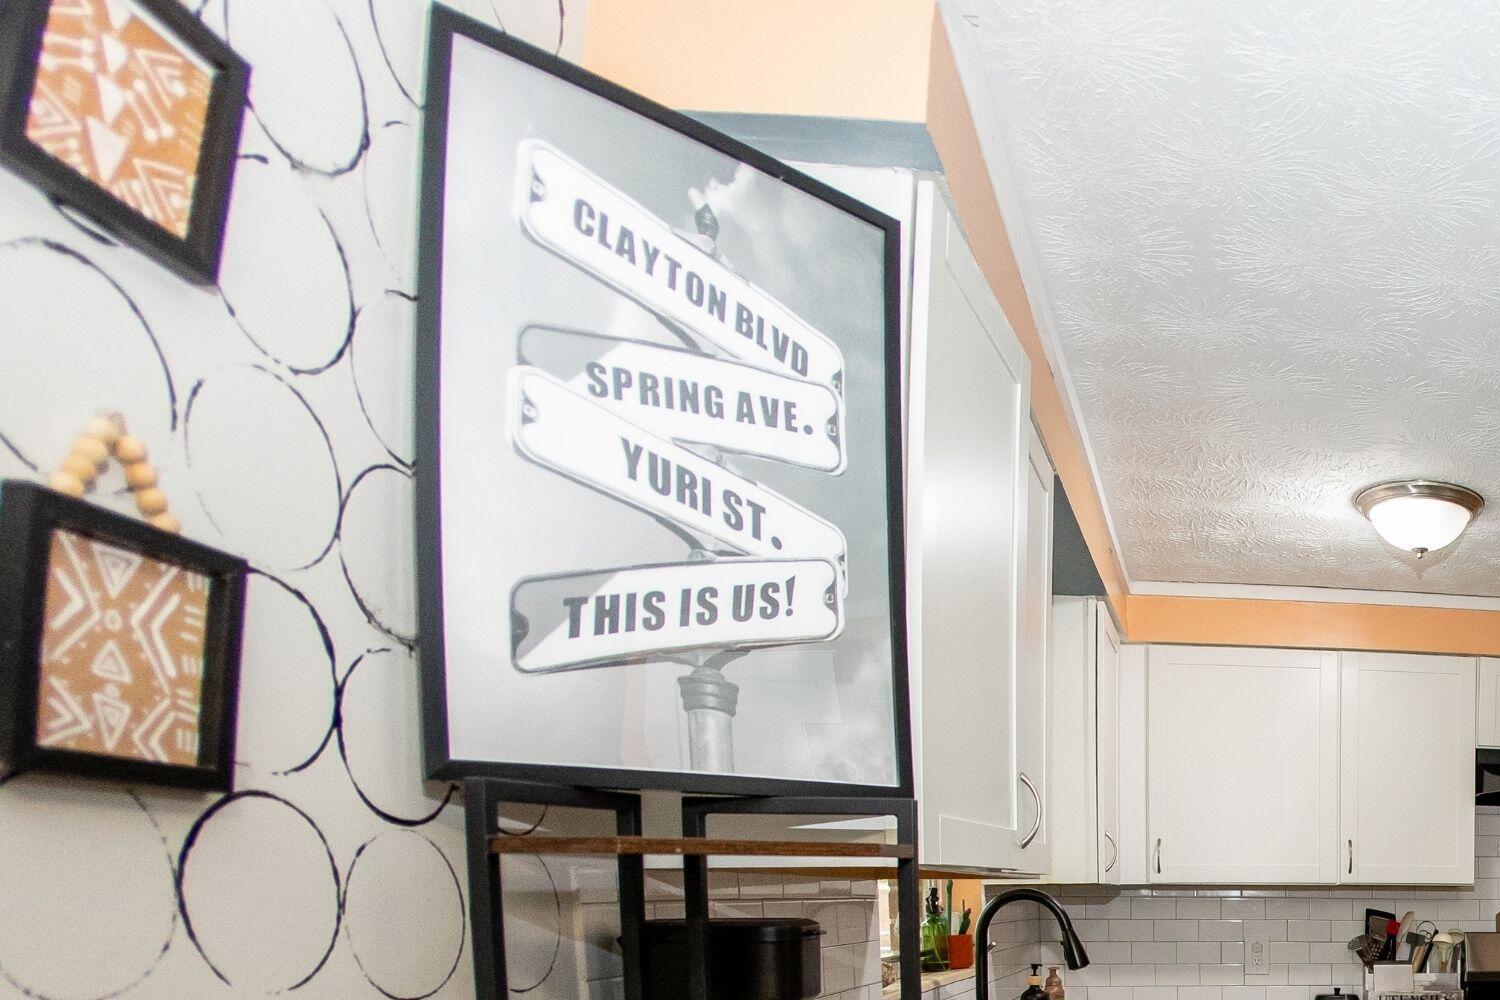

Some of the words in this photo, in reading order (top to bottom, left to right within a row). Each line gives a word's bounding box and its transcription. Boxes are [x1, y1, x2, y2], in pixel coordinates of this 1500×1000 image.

[572, 196, 727, 325] CLAYTON
[734, 299, 810, 378] BLVD
[585, 360, 725, 421] SPRING
[735, 392, 815, 436] AVE.
[620, 436, 713, 517] YURI
[721, 487, 783, 551] ST.
[562, 589, 667, 640] THIS
[679, 584, 719, 629] IS
[731, 574, 798, 625] US!
